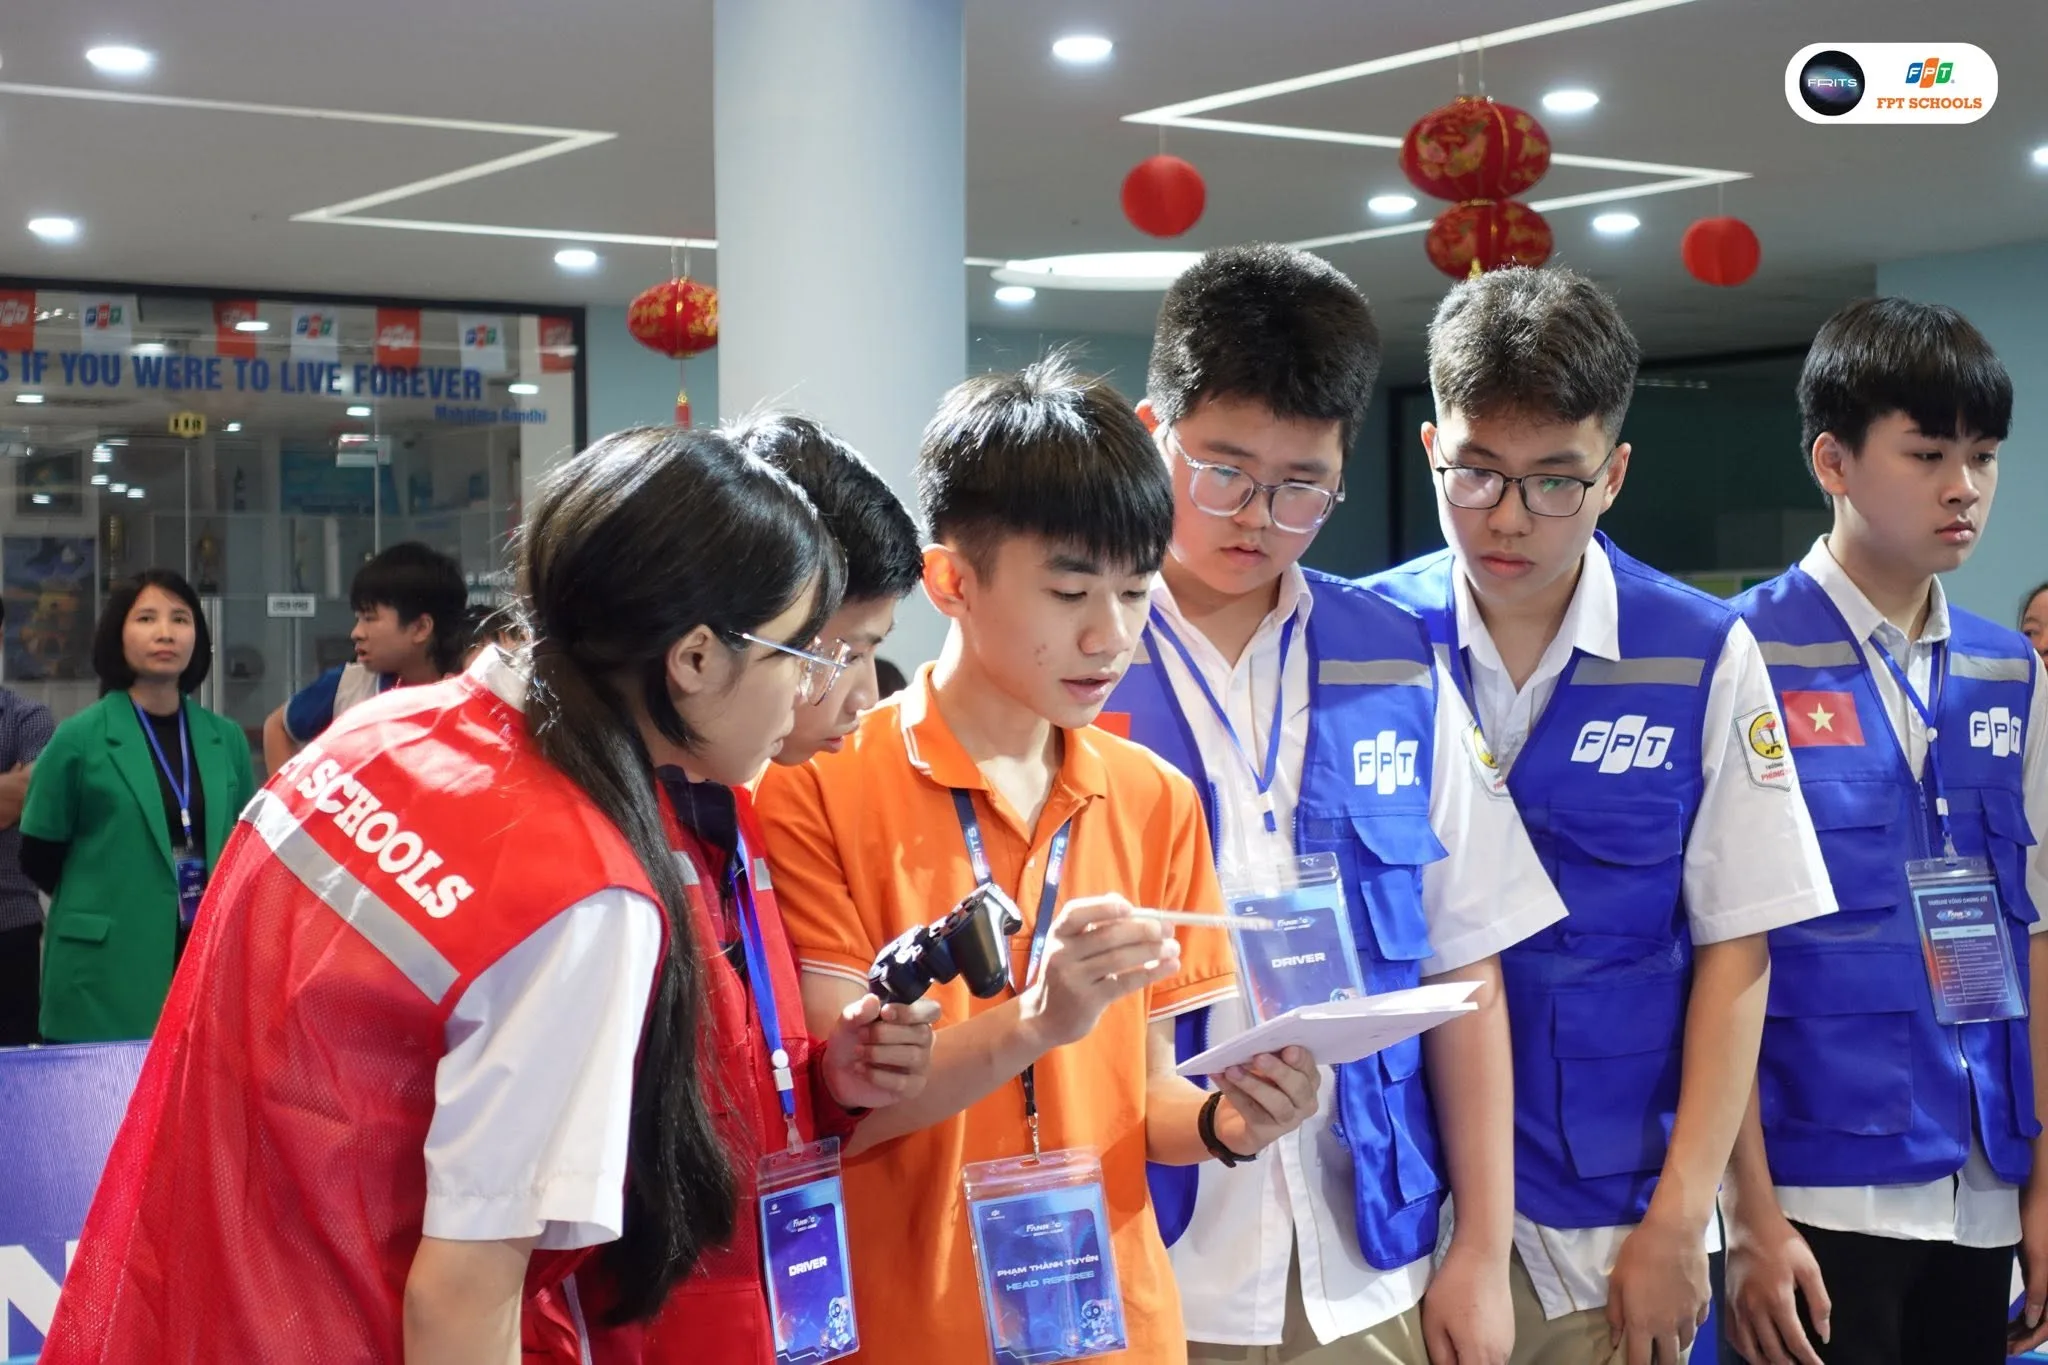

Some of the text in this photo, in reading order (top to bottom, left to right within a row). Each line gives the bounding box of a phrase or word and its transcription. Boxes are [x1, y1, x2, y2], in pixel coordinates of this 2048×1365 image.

[21, 353, 48, 384] IF
[60, 352, 121, 388] YOU
[132, 355, 222, 391] WERE
[233, 358, 269, 392] TO
[281, 361, 342, 395] LIVE
[354, 364, 482, 400] FOREVER
[1570, 714, 1675, 774] FPT
[1969, 707, 2022, 757] FPT
[1353, 730, 1419, 794] FPT
[296, 759, 475, 919] SCHOOLS
[1271, 952, 1326, 968] DRIVER
[788, 1255, 828, 1277] DRIVER
[997, 1264, 1027, 1277] PHẠM
[1006, 1270, 1095, 1291] HEAD REFEREE
